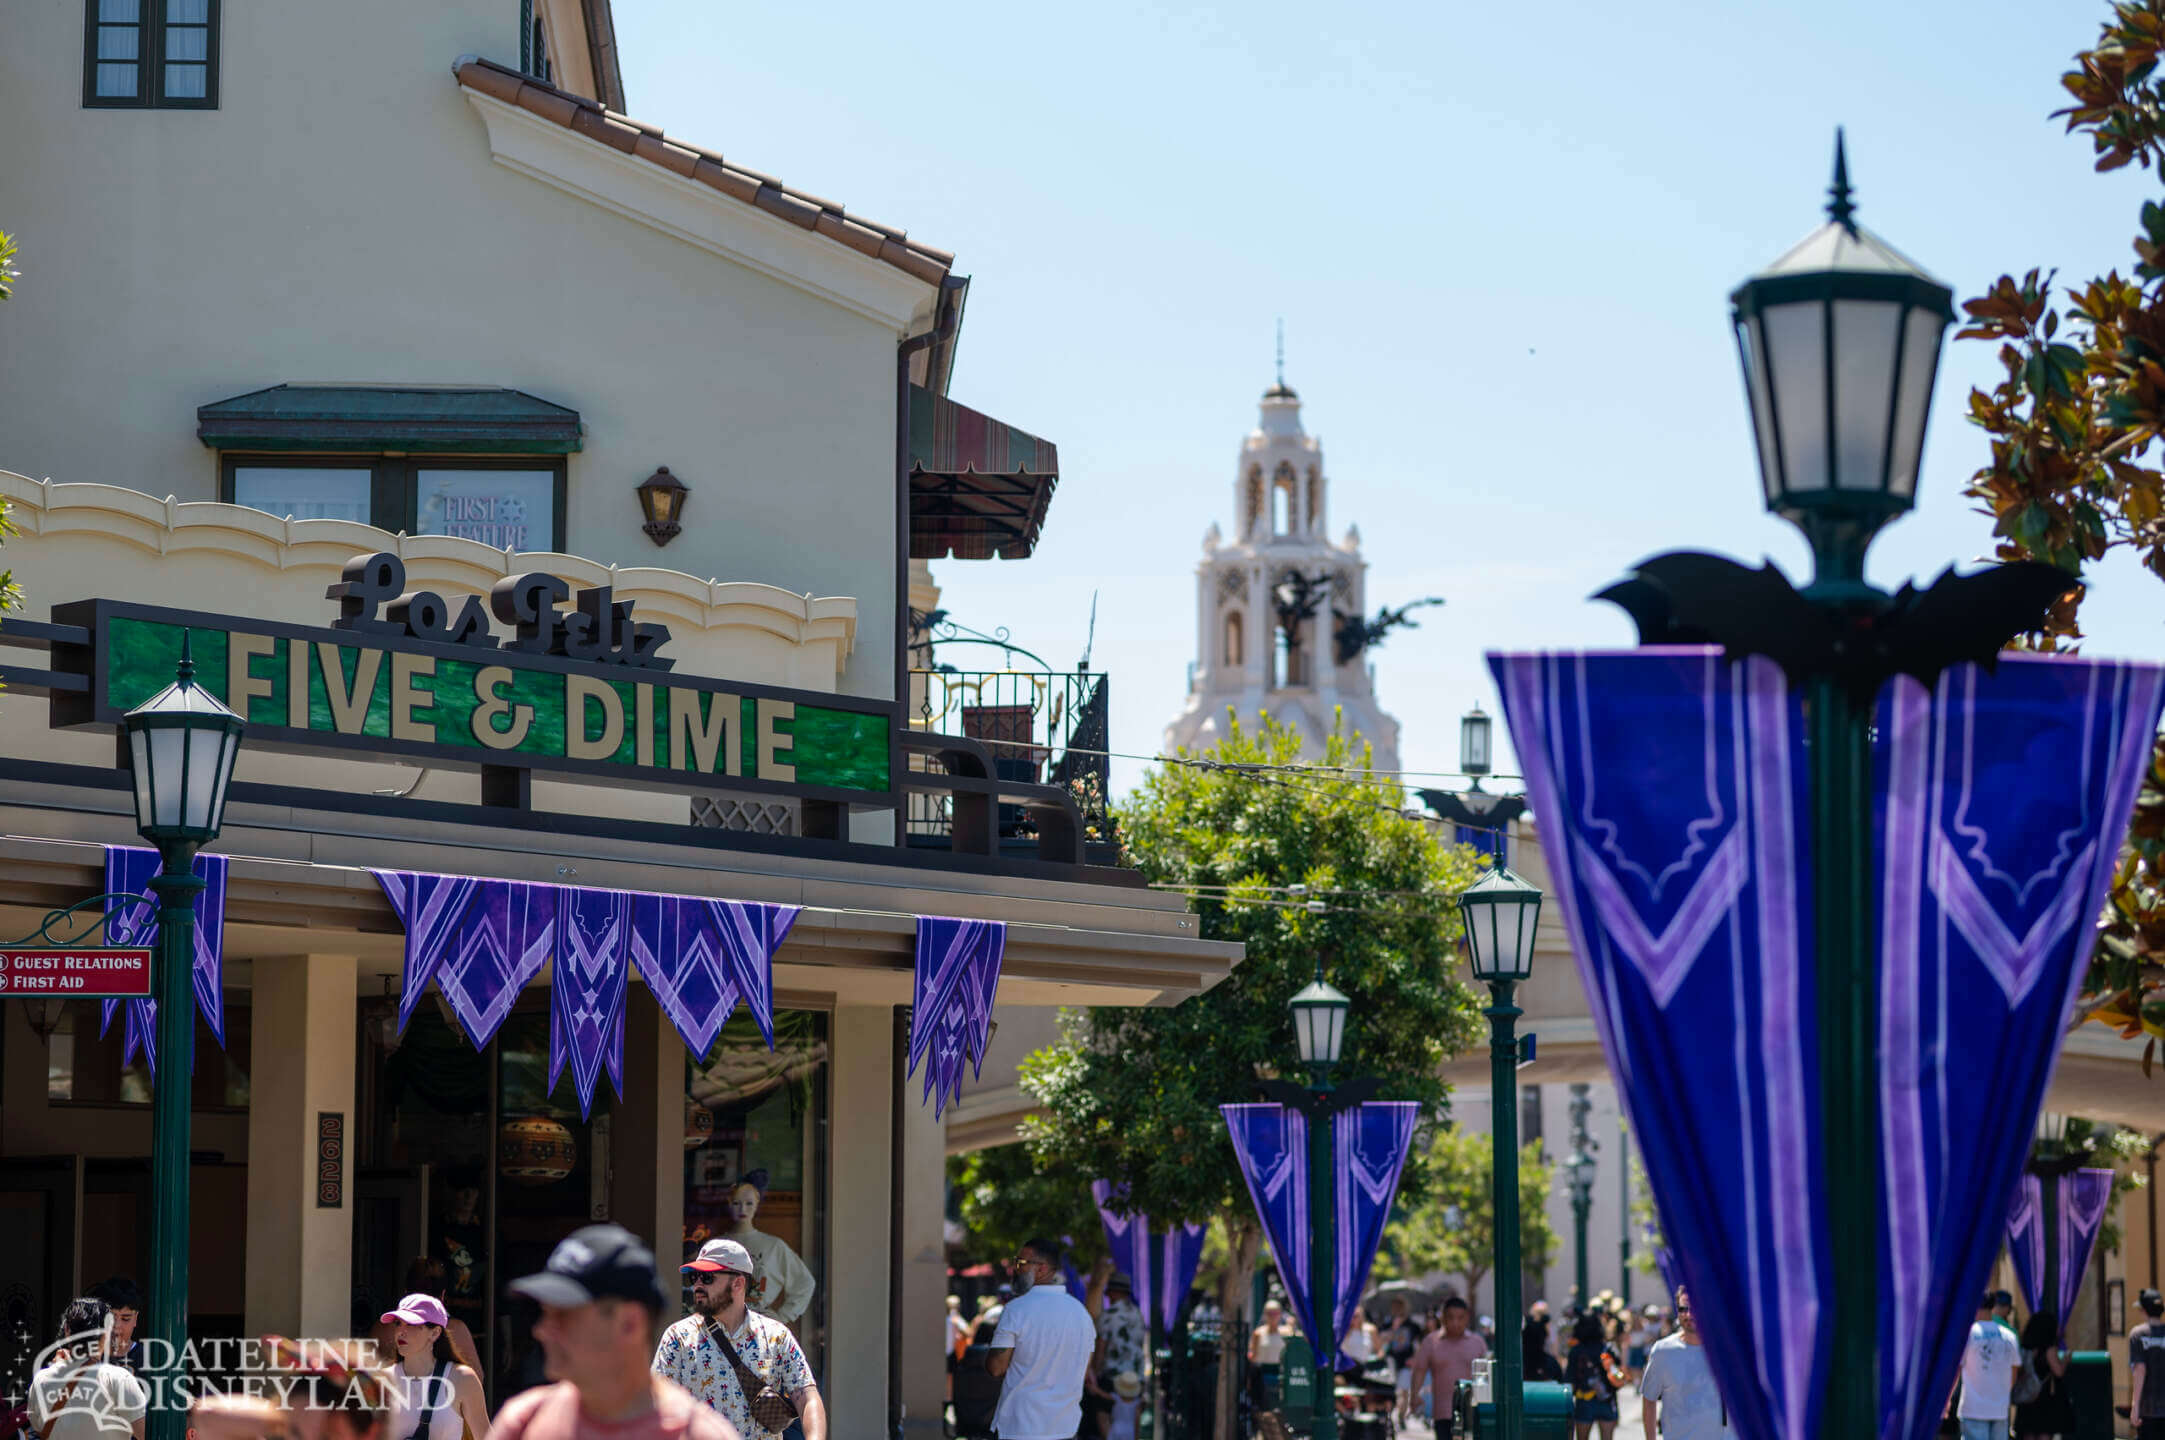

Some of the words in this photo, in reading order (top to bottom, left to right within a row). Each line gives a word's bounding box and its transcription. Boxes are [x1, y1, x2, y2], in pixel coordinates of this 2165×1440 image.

[443, 496, 498, 521] FIRST
[326, 552, 500, 650] Los
[229, 631, 436, 743] FIVE
[470, 665, 535, 750] &
[567, 673, 796, 783] DIME
[13, 956, 61, 970] GUEST
[64, 956, 142, 970] RELATIONS
[13, 975, 56, 989] FIRST
[58, 975, 85, 989] AID
[320, 1118, 341, 1203] 2628
